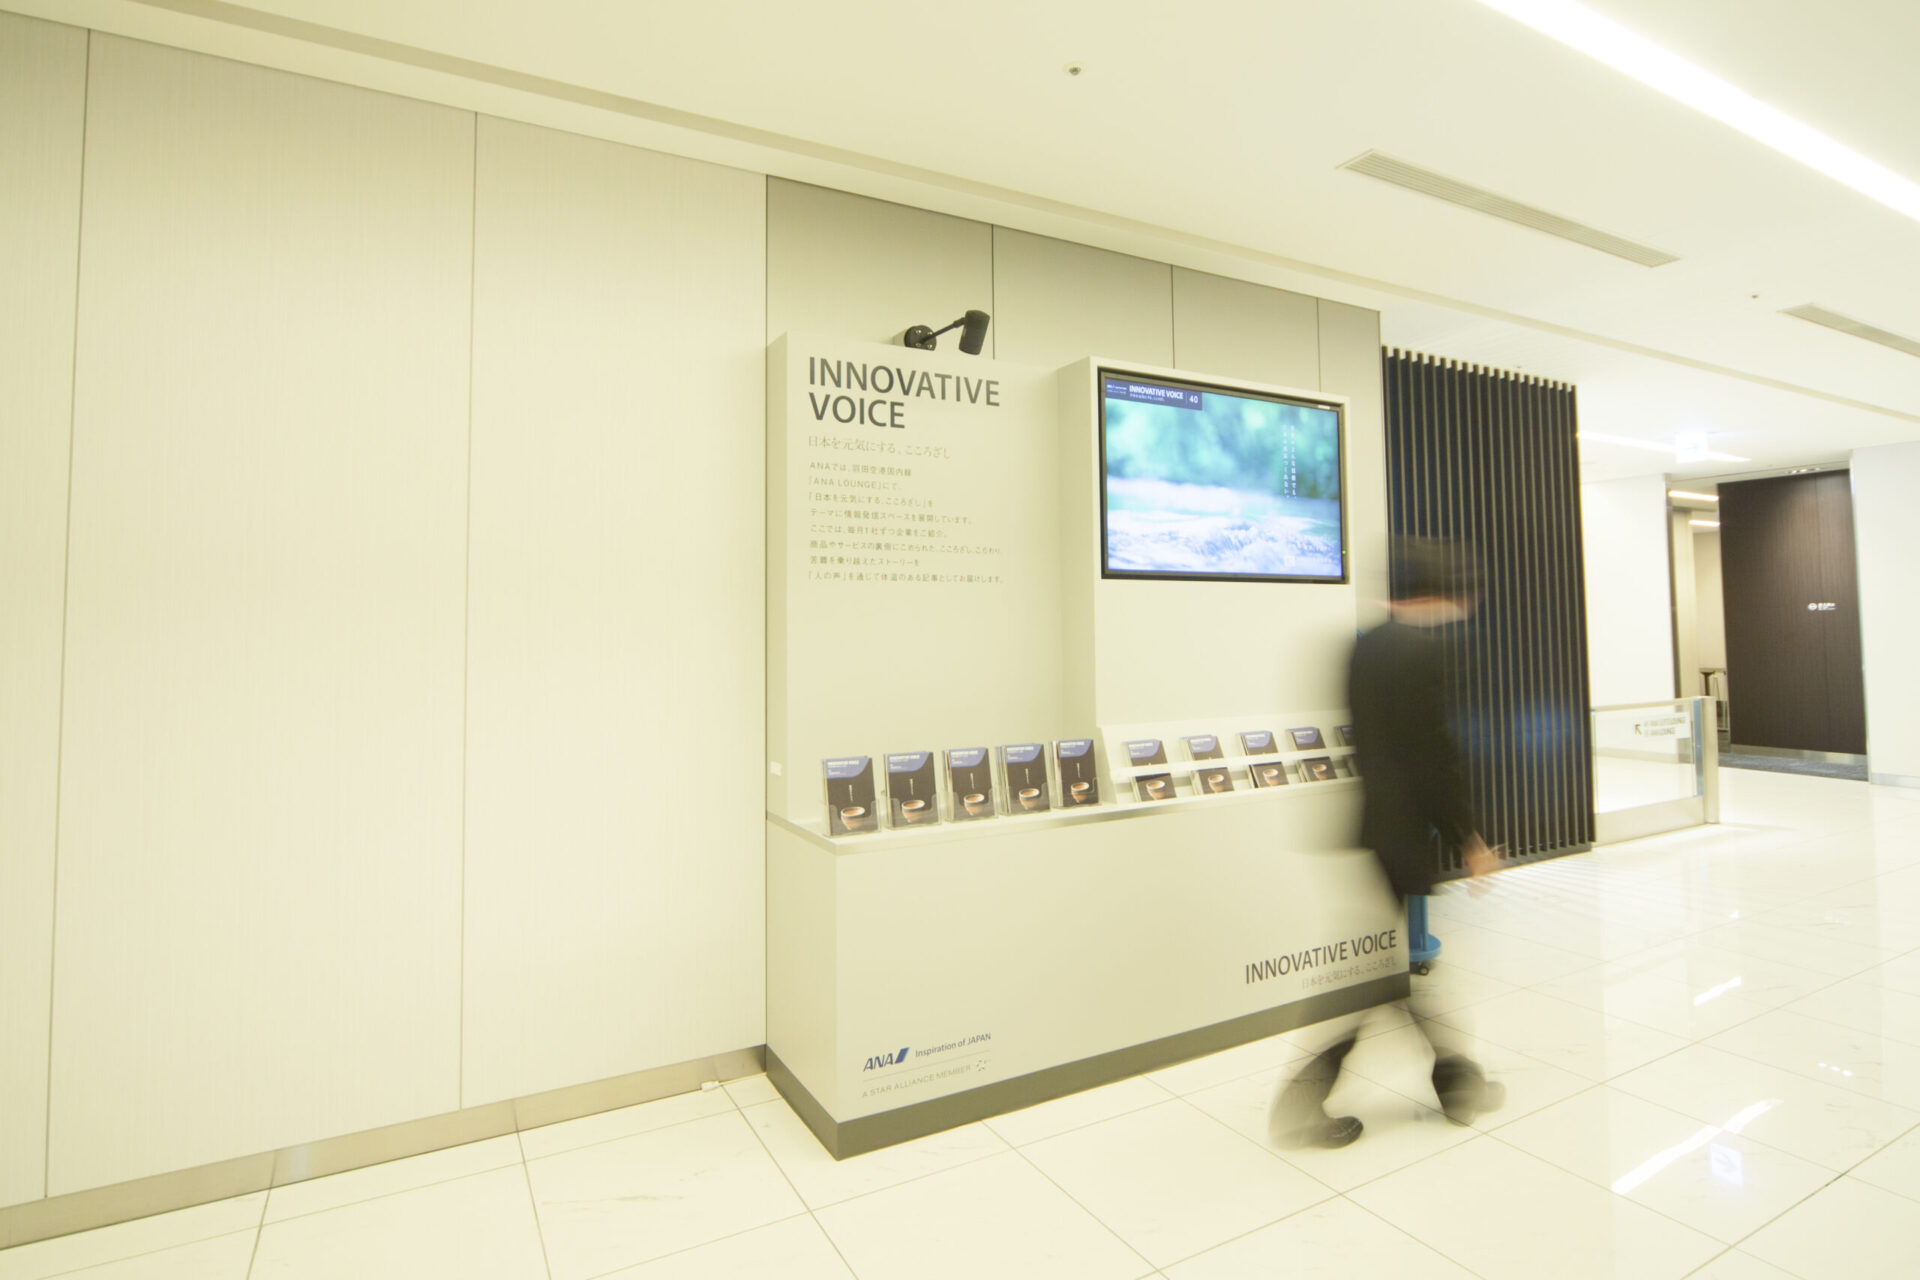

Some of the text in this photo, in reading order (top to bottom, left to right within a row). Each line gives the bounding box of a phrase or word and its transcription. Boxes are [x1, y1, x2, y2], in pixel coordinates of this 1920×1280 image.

[809, 356, 1000, 407] INNOVATIVE
[1129, 384, 1165, 397] INNOVATIVE
[1166, 390, 1184, 399] VOICE
[809, 392, 905, 429] VOICE
[808, 436, 951, 460] 日本を元気にする、こころざし
[1245, 929, 1397, 985] INNOVATIVE VOICE
[863, 1032, 992, 1072] ANA Inspiration of JAPAN
[870, 1085, 892, 1096] STAR
[894, 1073, 934, 1090] ALLIANCE
[936, 1064, 971, 1080] MEMBER
